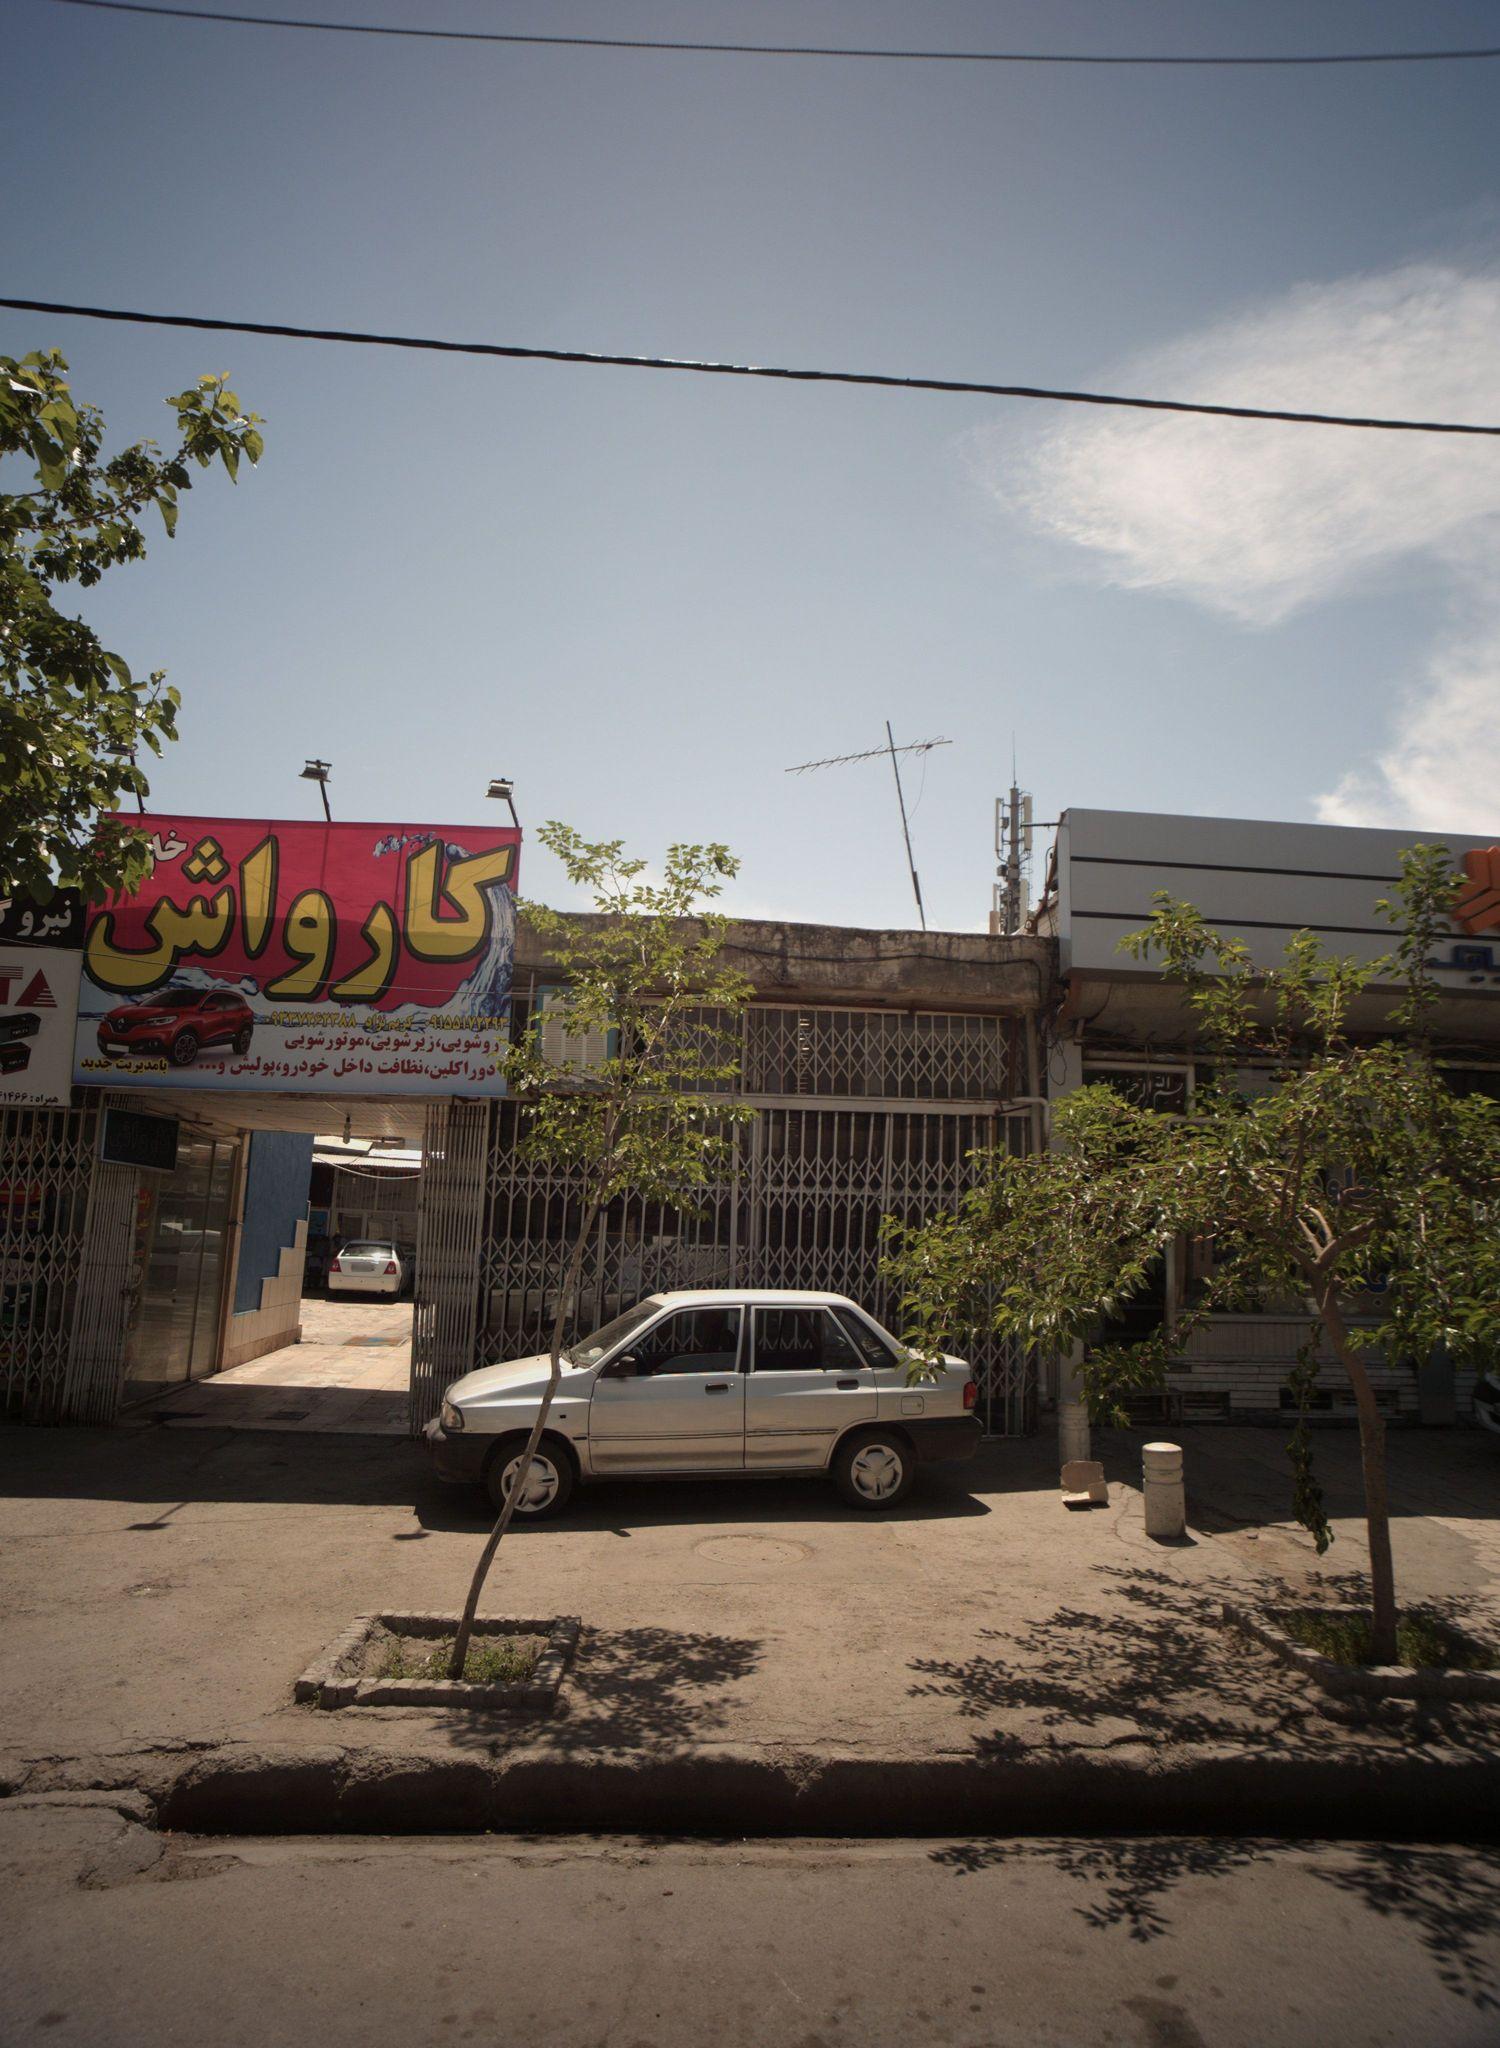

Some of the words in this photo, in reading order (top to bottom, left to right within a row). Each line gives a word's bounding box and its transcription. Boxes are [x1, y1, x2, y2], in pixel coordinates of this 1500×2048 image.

[16, 899, 72, 937] نیرو
[83, 833, 516, 1002] کارواش
[81, 1058, 112, 1072] جدید
[333, 1058, 373, 1076] داخل
